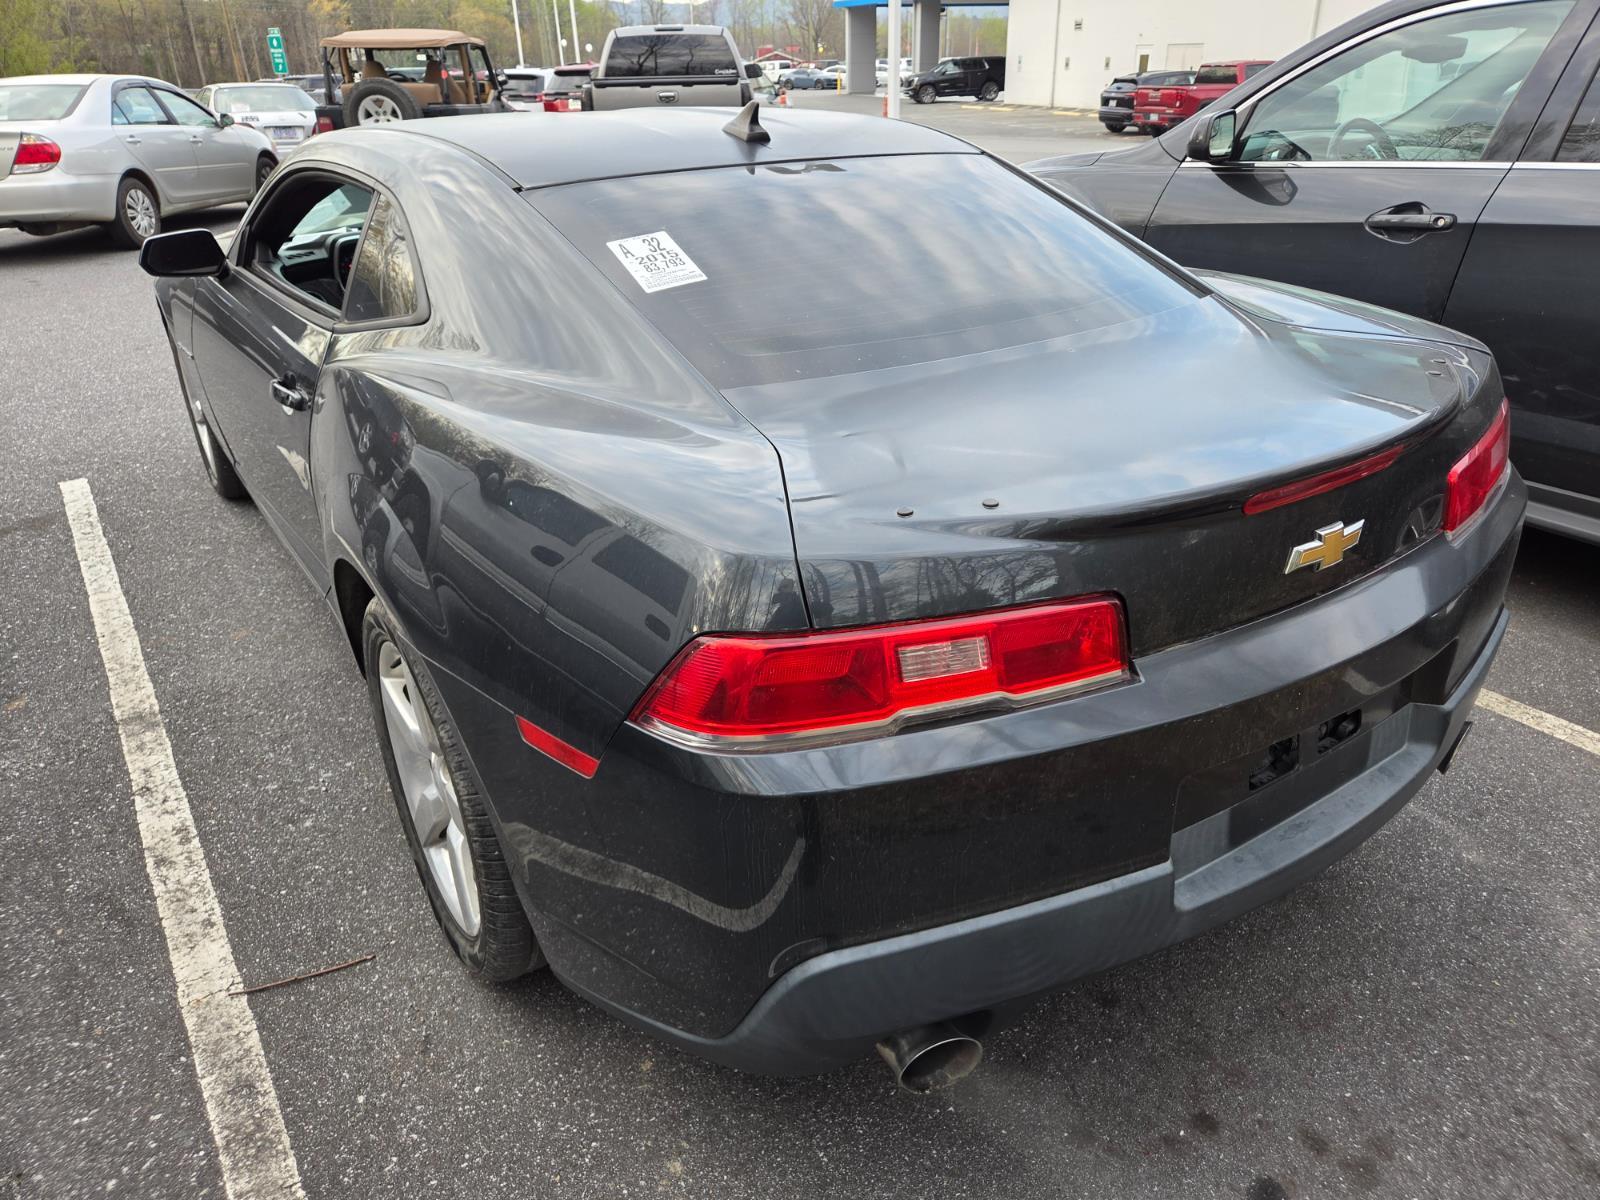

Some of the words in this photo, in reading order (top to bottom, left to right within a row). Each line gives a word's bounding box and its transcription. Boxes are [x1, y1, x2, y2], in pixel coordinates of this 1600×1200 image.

[618, 243, 636, 259] A
[642, 236, 666, 253] 32
[635, 249, 679, 265] 2015
[643, 257, 686, 273] 83,793
